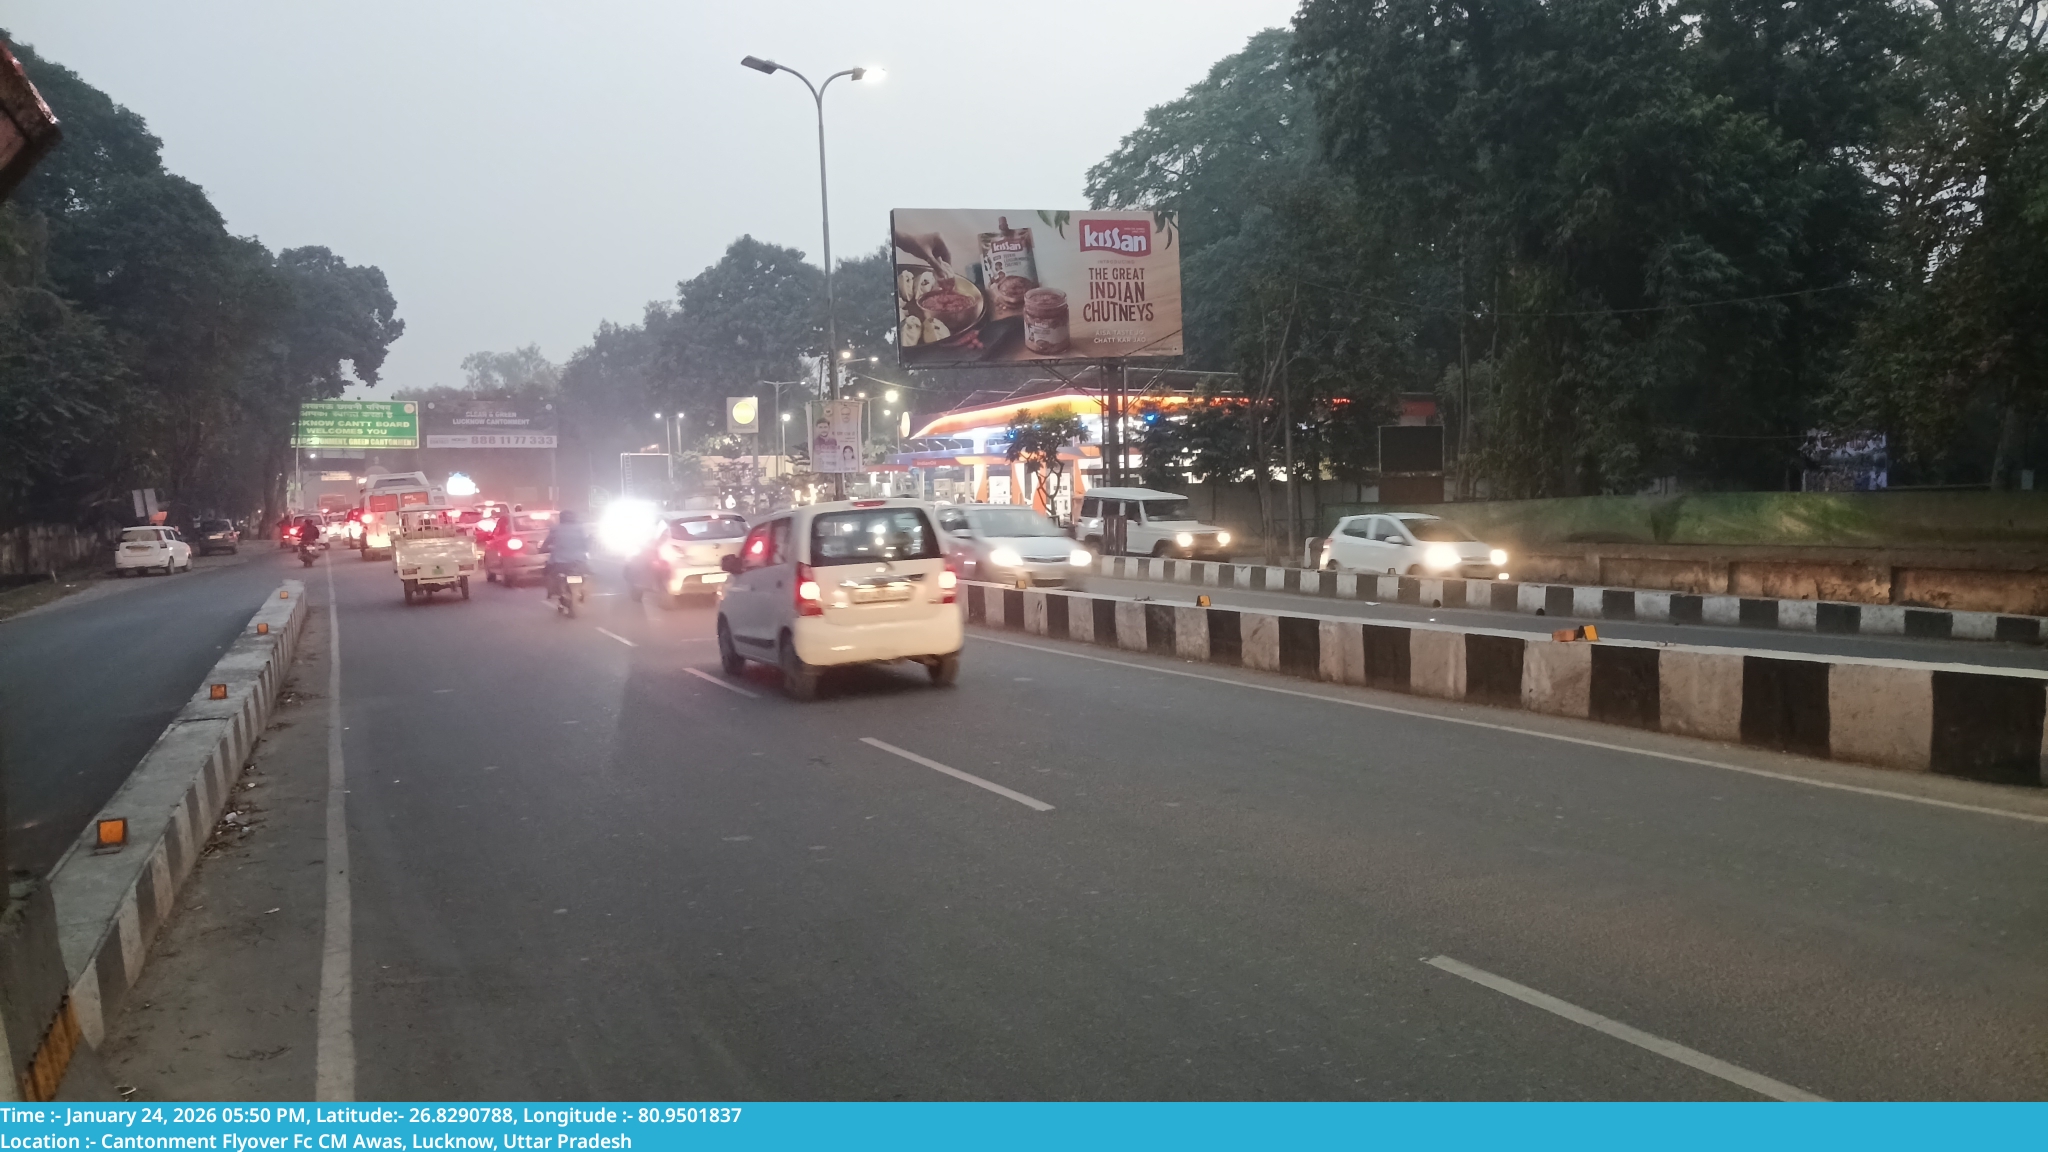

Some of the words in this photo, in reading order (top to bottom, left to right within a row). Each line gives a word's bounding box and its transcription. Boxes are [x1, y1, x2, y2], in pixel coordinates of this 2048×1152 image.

[1088, 267, 1108, 280] THE
[1112, 267, 1145, 280] GREAT
[1089, 281, 1145, 303] INDIAN
[1083, 300, 1154, 322] CHUTNEYS
[471, 436, 496, 444] 888
[530, 436, 553, 445] 333
